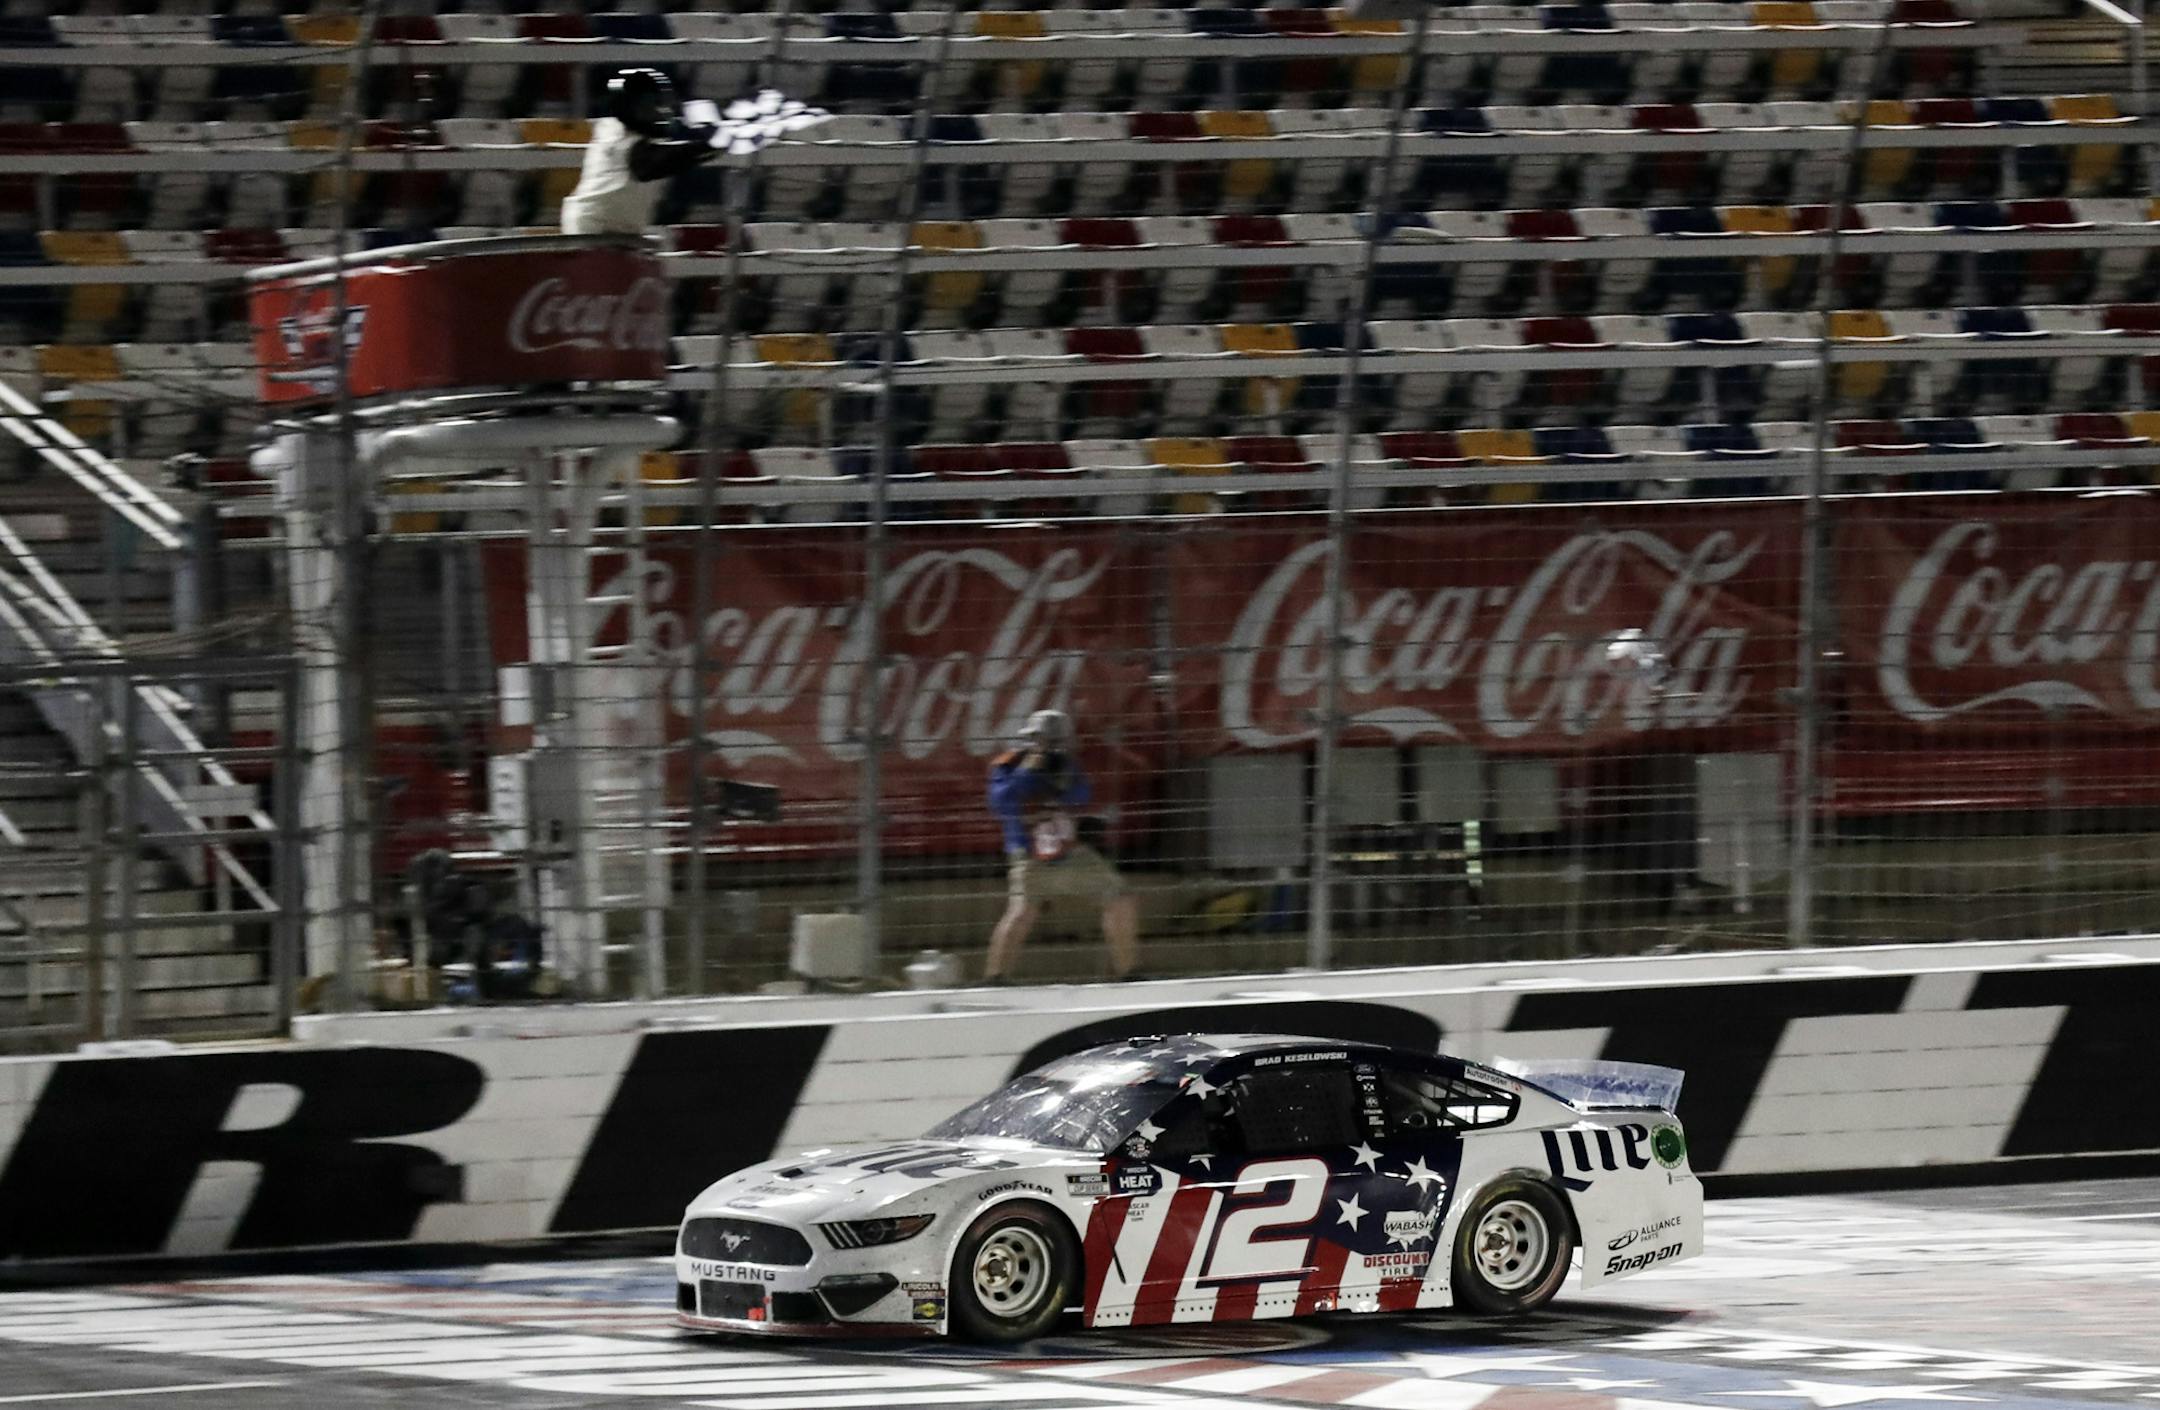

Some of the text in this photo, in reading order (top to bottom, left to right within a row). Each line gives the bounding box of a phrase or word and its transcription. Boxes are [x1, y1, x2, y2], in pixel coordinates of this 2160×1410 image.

[1877, 520, 2160, 725] Coca-
[1220, 528, 1768, 750] Coca-Cola
[1255, 1052, 1348, 1067] BRAD KESELOWSKI
[978, 1180, 1053, 1201] GOODYEAR
[1120, 1175, 1154, 1188] HEAT
[1204, 1157, 1330, 1285] 2
[1385, 1220, 1434, 1231] WABASH
[1641, 1216, 1682, 1235] ALLIANCE
[1364, 1253, 1429, 1268] DISCOUNT
[691, 1263, 776, 1281] MUSTANG
[1382, 1267, 1408, 1276] TIRE
